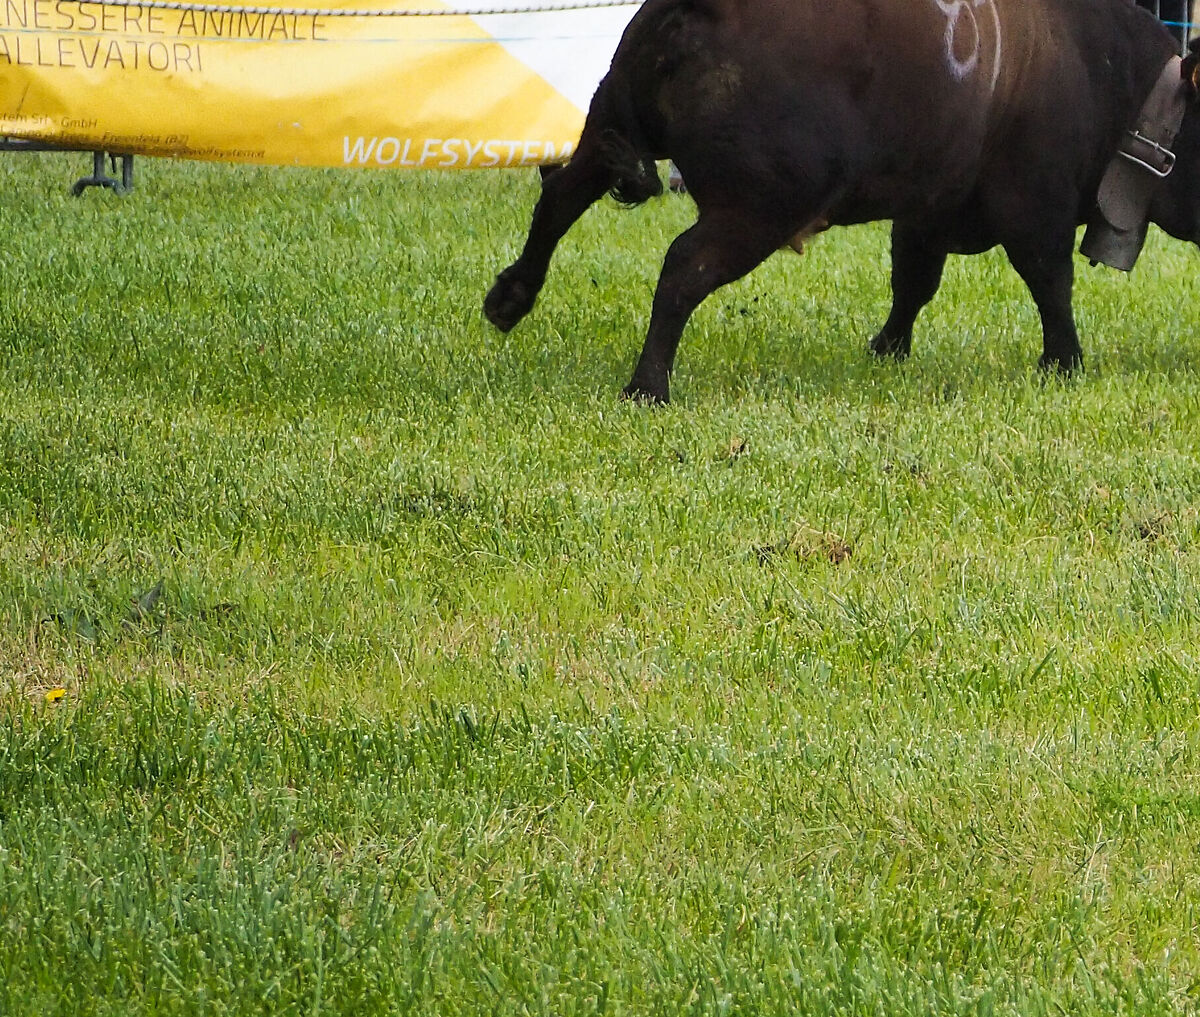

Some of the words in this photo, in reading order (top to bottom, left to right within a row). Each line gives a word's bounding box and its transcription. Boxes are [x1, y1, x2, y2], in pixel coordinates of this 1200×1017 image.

[178, 7, 329, 41] ANIMALE
[60, 116, 98, 130] GmbH
[342, 135, 573, 166] WOLFSYSTEM
